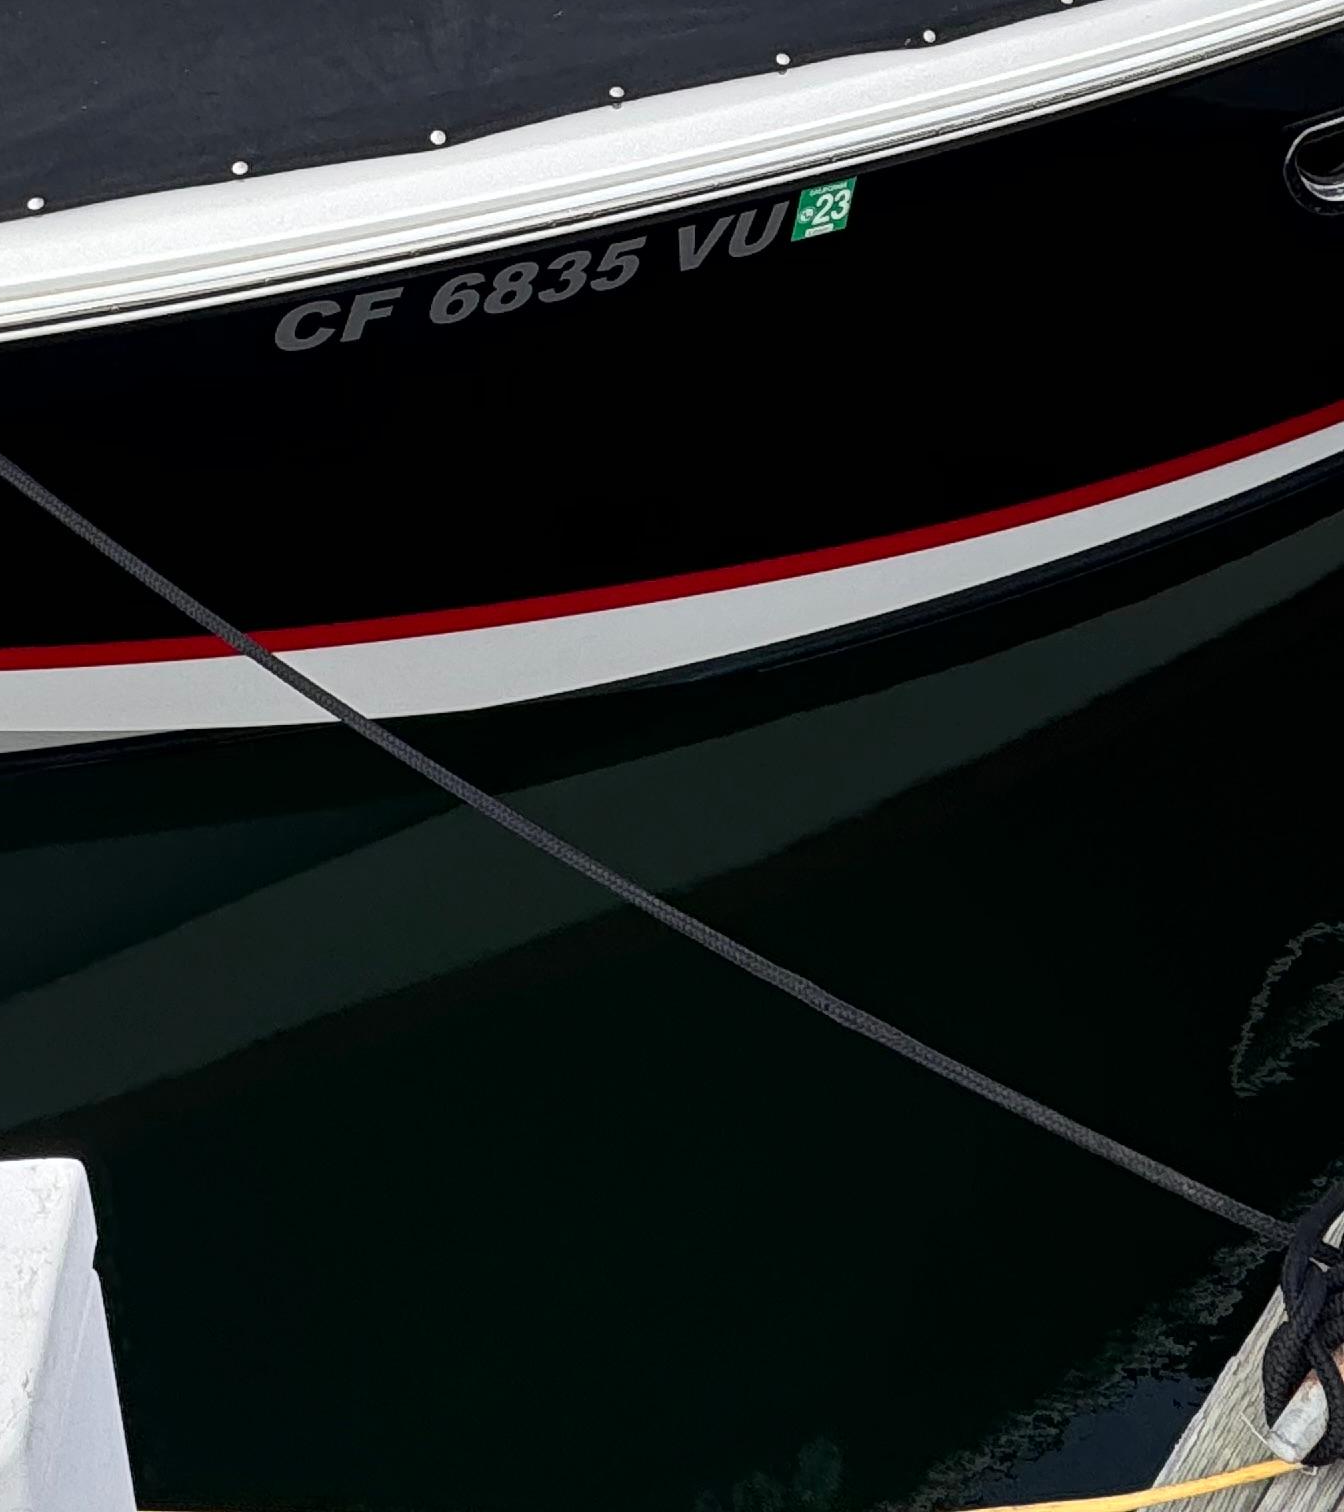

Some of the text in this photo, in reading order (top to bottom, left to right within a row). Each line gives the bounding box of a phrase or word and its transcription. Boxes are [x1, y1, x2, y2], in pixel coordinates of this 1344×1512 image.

[811, 189, 851, 226] 23
[274, 200, 790, 351] CF 6835 VU
